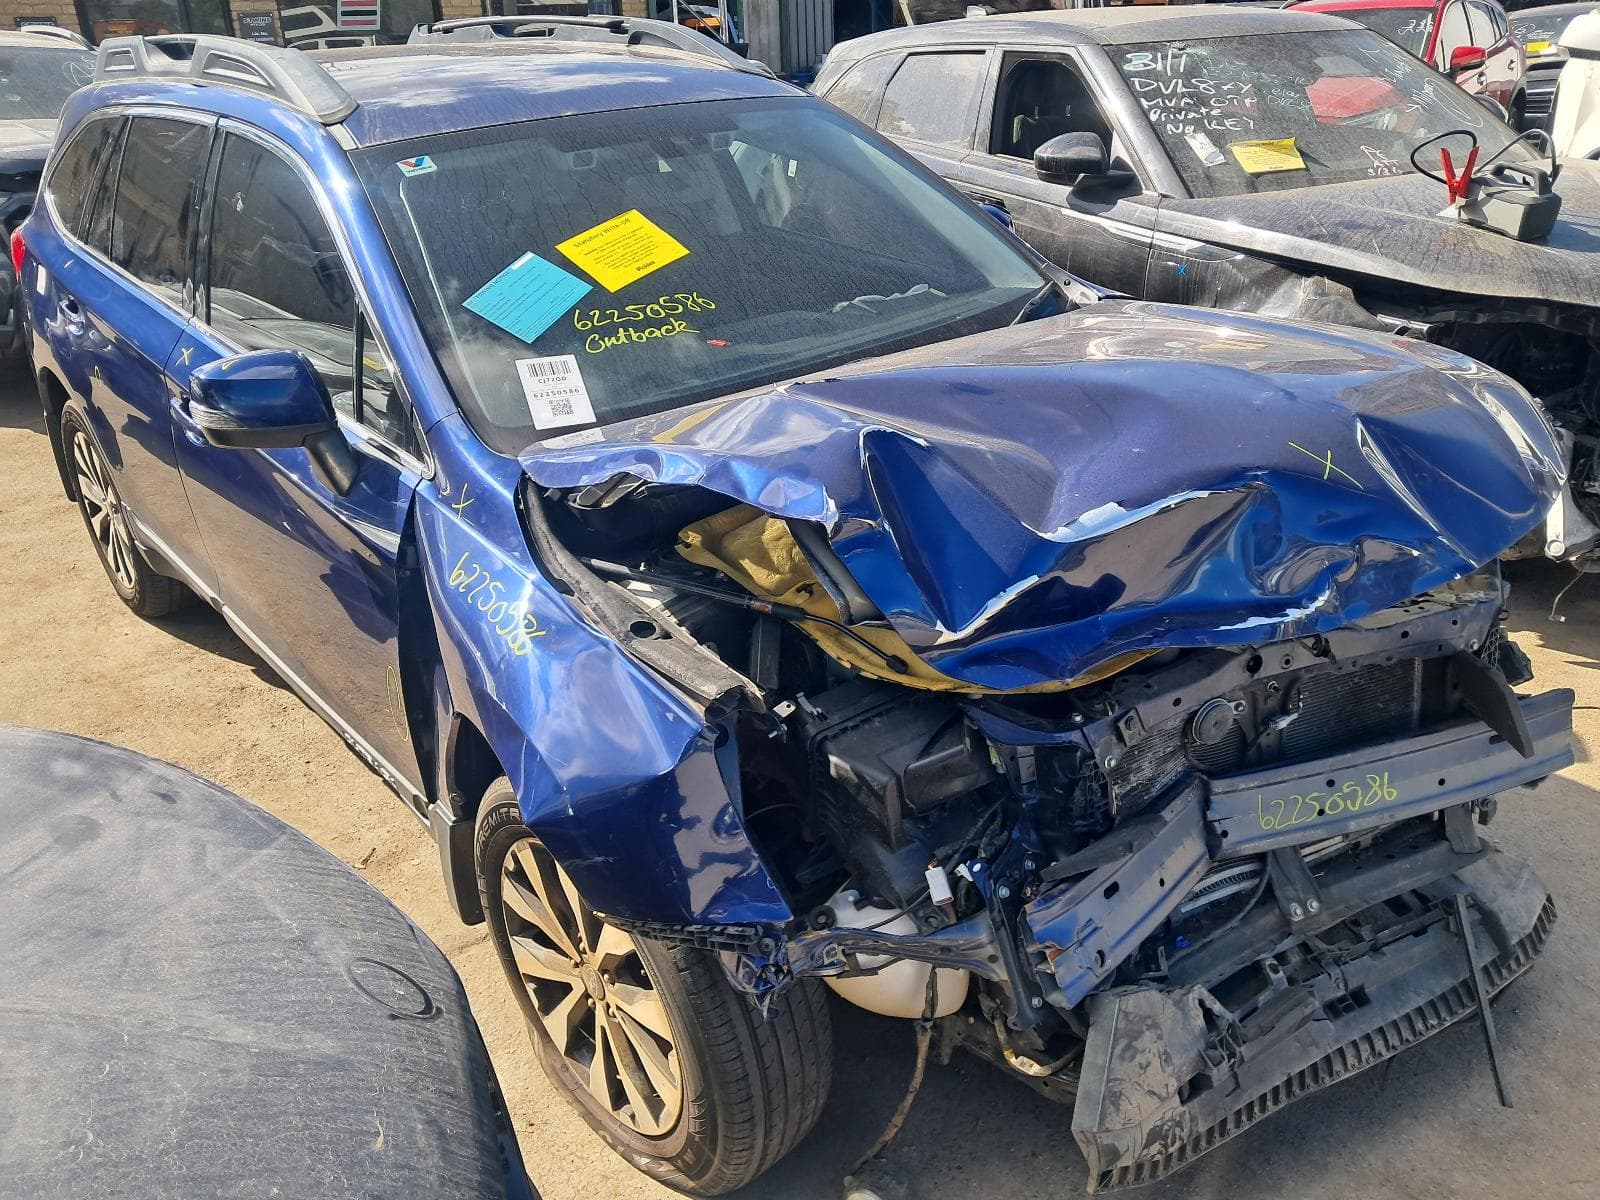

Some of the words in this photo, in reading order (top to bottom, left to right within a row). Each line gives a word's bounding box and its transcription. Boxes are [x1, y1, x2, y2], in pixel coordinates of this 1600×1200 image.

[1204, 117, 1254, 131] KEY
[573, 291, 716, 331] 62250586
[585, 317, 700, 354] Outback
[533, 388, 580, 399] 62250586
[449, 551, 546, 656] 62250586
[1258, 771, 1398, 830] 62250586
[476, 807, 524, 862] PREMITR
